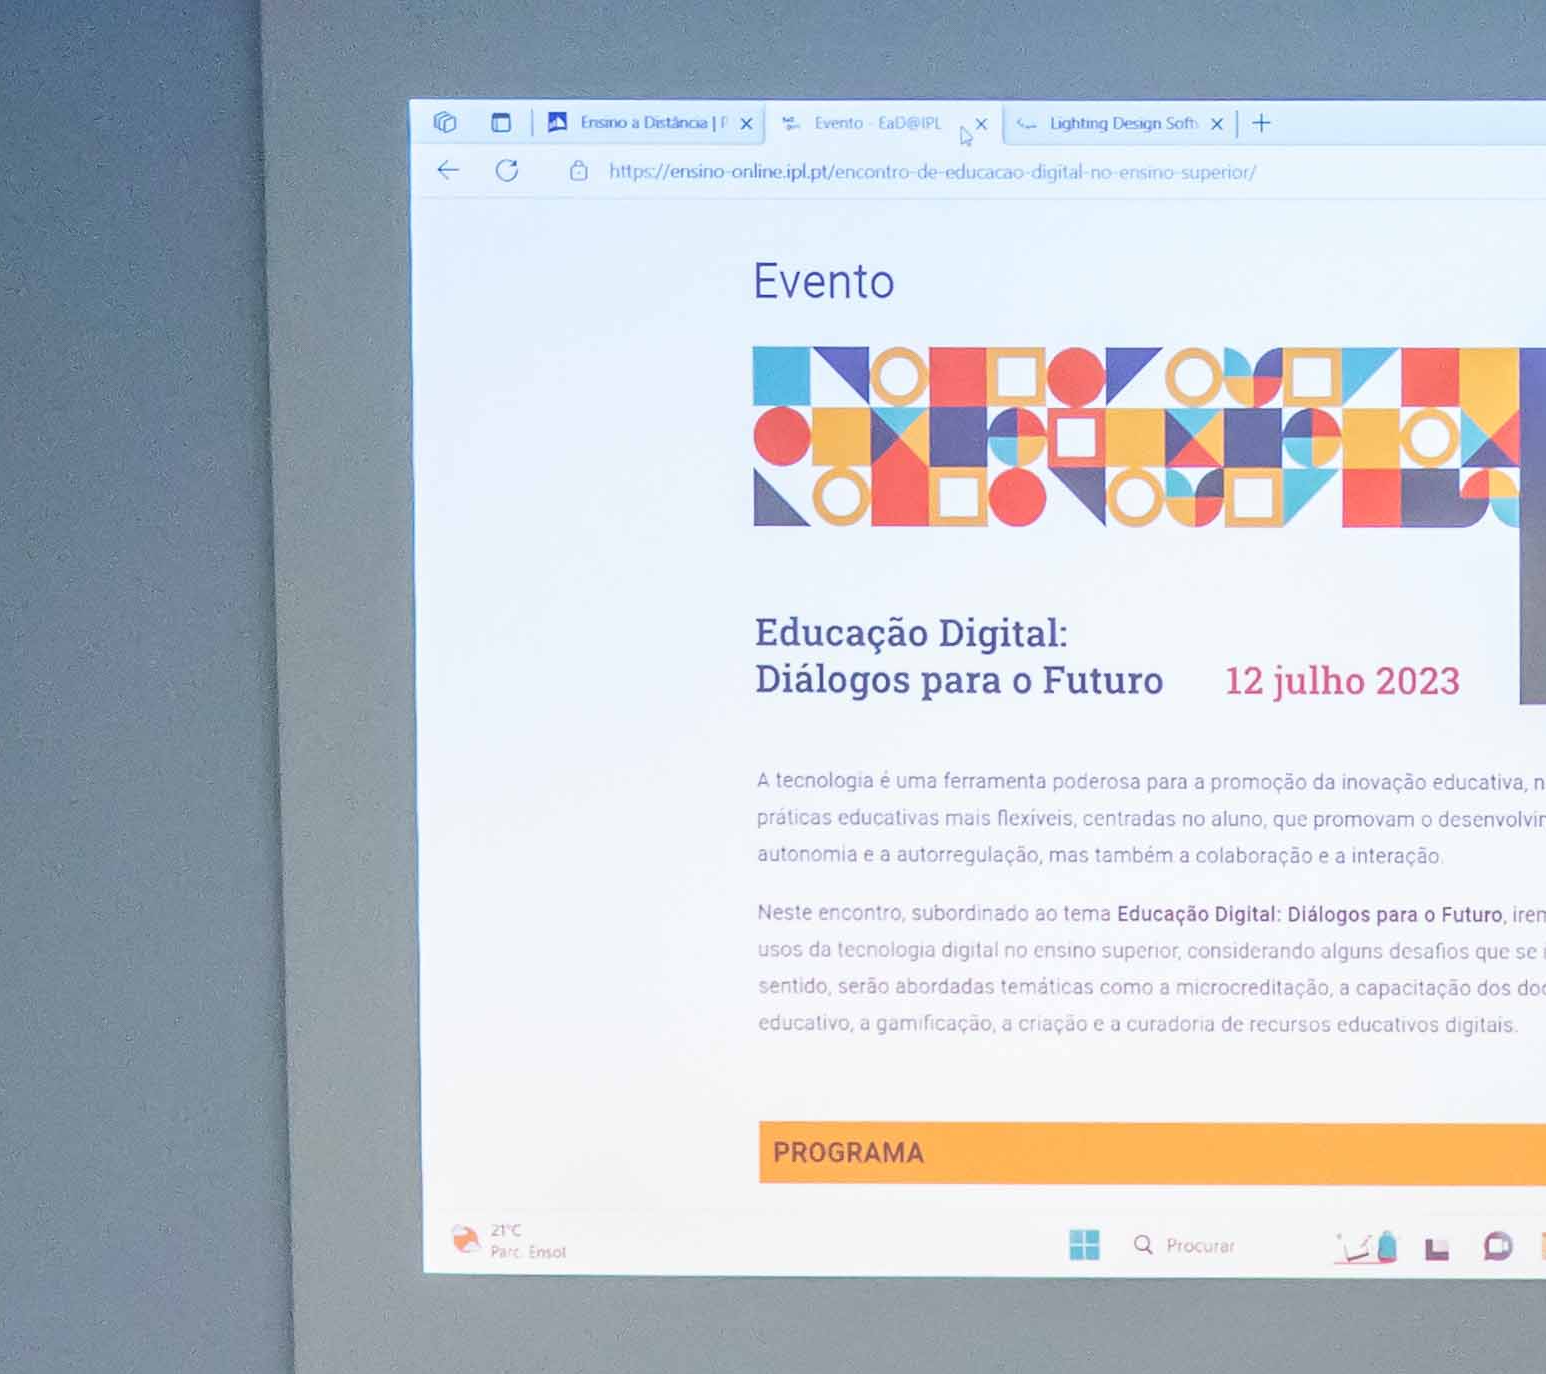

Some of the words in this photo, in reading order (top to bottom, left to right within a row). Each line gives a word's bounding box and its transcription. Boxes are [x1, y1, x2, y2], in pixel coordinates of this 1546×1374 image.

[582, 115, 627, 128] Ensino
[644, 116, 708, 129] Distância
[814, 116, 863, 130] Evento
[878, 115, 943, 131] EaD@IPL
[1051, 117, 1108, 133] Lighting
[1113, 117, 1161, 133] Design
[756, 262, 894, 299] Evento
[756, 616, 927, 655] Educação
[940, 617, 1066, 655] Digital:
[756, 663, 910, 701] Diálogos
[921, 672, 1001, 701] para
[1013, 673, 1031, 694] o
[1043, 666, 1163, 694] Futuro
[1227, 666, 1263, 694] 12
[1273, 665, 1365, 702] julho
[1376, 667, 1459, 695] 2023
[758, 772, 770, 787] A
[776, 771, 873, 792] tecnologia
[880, 770, 890, 789] é
[897, 776, 936, 788] uma
[944, 771, 1046, 789] ferramenta
[1054, 773, 1140, 792] poderosa
[1147, 777, 1187, 793] para
[1194, 777, 1204, 789] a
[1211, 773, 1307, 794] promoção
[1313, 773, 1334, 790] da
[1342, 773, 1426, 794] inovação
[1433, 774, 1528, 792] educativa,
[758, 808, 832, 829] práticas
[838, 808, 939, 826] educativas
[946, 813, 990, 826] mais
[998, 808, 1077, 828] flexíveis,
[1083, 810, 1176, 827] centradas
[1183, 814, 1205, 827] no
[1212, 810, 1267, 829] aluno,
[1273, 814, 1307, 831] que
[1314, 814, 1414, 831] promovam
[1422, 815, 1432, 828] o
[758, 846, 857, 862] autonomia
[864, 849, 874, 862] e
[880, 849, 890, 862] a
[897, 846, 1042, 866] autorregulação,
[1049, 850, 1089, 863] mas
[1095, 845, 1173, 863] também
[1179, 850, 1189, 863] a
[1196, 846, 1313, 867] colaboração
[1319, 851, 1329, 864] e
[1335, 851, 1345, 864] a
[1352, 846, 1444, 867] interação.
[759, 904, 812, 920] Neste
[819, 906, 905, 922] encontro,
[912, 904, 1028, 921] subordinado
[1036, 908, 1057, 921] ao
[1064, 906, 1110, 921] tema
[1118, 905, 1209, 927] Educação
[1216, 905, 1281, 926] Digital:
[1288, 905, 1370, 926] Diálogos
[1377, 910, 1418, 927] para
[1425, 909, 1435, 923] o
[1442, 907, 1507, 925] Futuro,
[774, 1141, 924, 1163] PROGRAMA
[1167, 1238, 1234, 1254] Procurar
